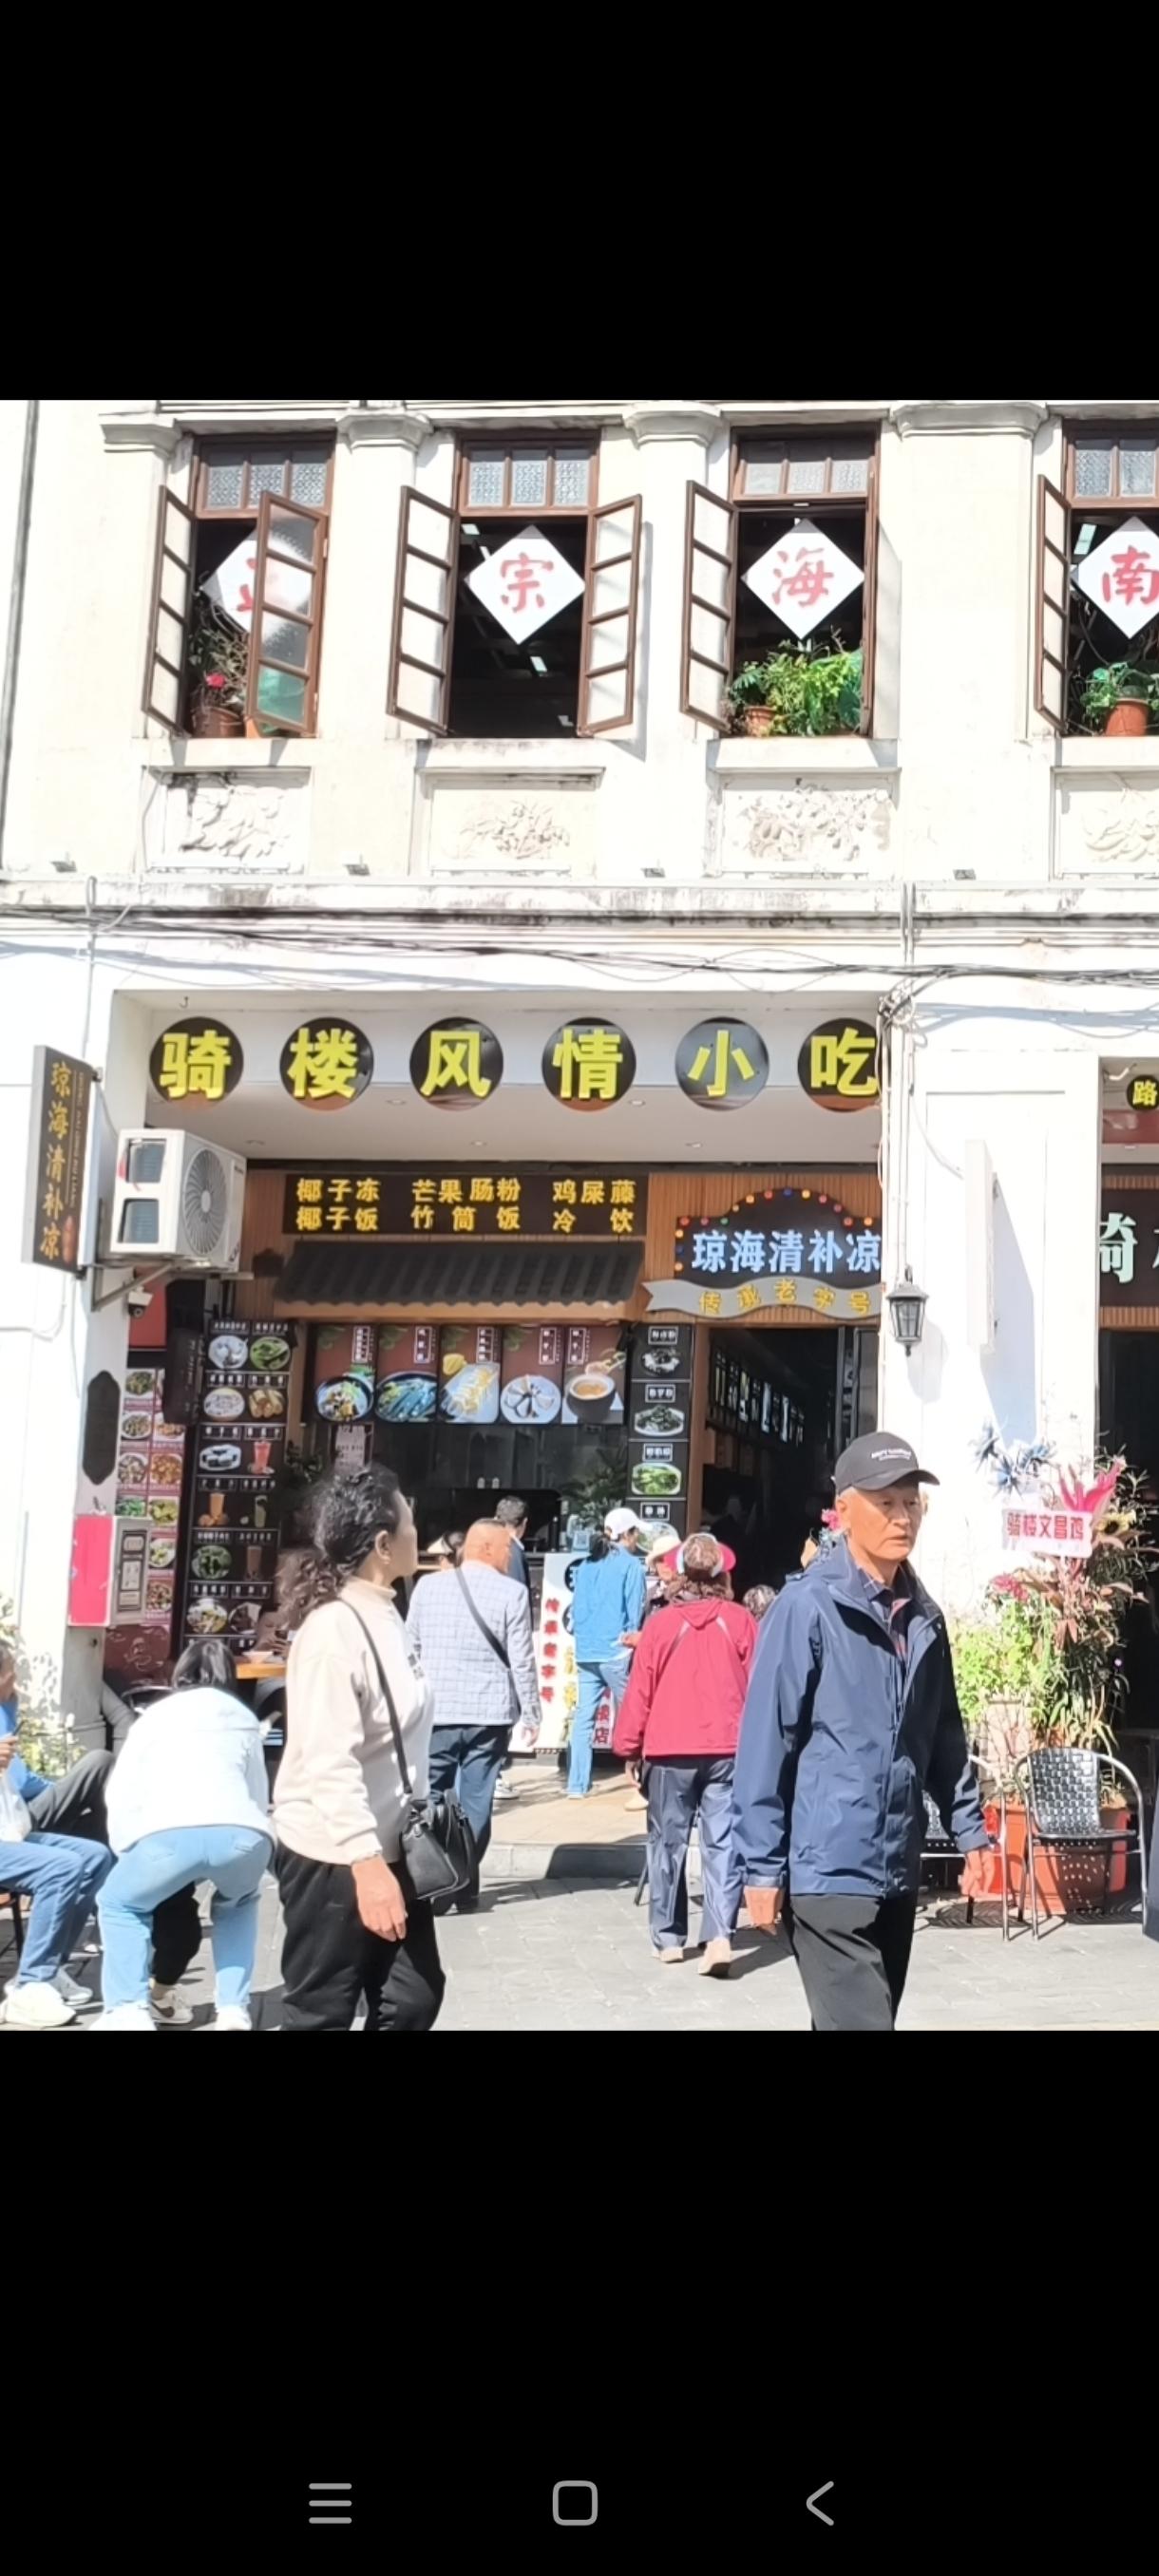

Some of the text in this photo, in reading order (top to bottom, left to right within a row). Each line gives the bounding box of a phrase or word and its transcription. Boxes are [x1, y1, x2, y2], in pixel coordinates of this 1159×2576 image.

[500, 553, 554, 614] 宗
[771, 547, 834, 607] 海
[1102, 544, 1159, 605] 南
[160, 1028, 880, 1100] 骑楼风情小吃
[1131, 1080, 1158, 1107] 路
[40, 1061, 71, 1260] 琼海清补凉
[296, 1178, 636, 1204] 椰子冻 芒果肠粉 鸡屎藤
[296, 1205, 635, 1233] 椰子饭 竹筒饭 冷饮
[692, 1229, 881, 1274] 琼海清补凉
[1099, 1212, 1159, 1282] 骑
